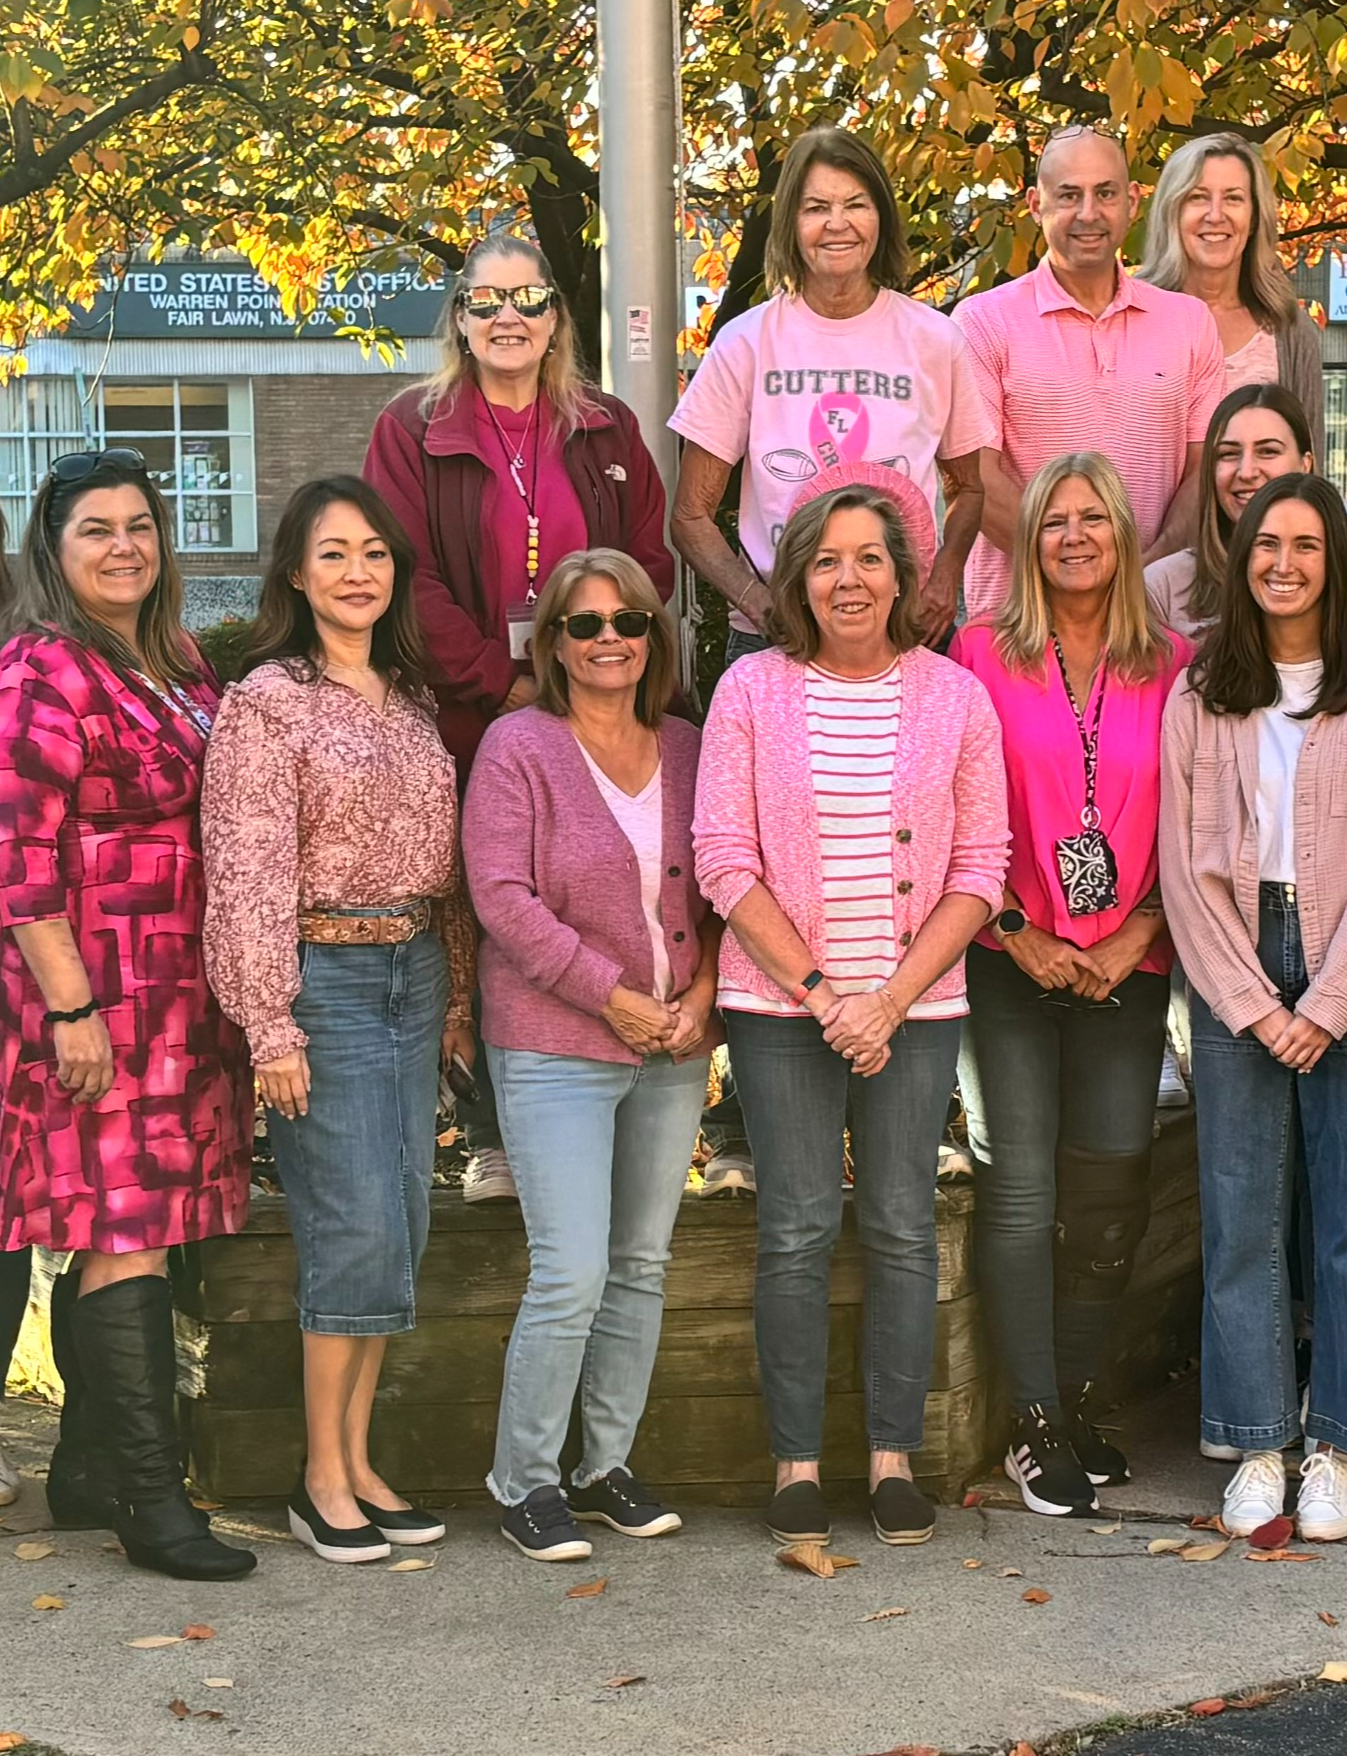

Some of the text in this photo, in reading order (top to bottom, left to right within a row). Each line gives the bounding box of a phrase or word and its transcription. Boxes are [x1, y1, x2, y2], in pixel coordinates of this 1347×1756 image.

[101, 273, 168, 292] NITED
[180, 272, 268, 292] STATES
[150, 293, 376, 309] WARREN POIN ATION
[168, 311, 205, 326] FAIR
[212, 311, 264, 328] LAWN,
[764, 369, 912, 401] CUTTERS
